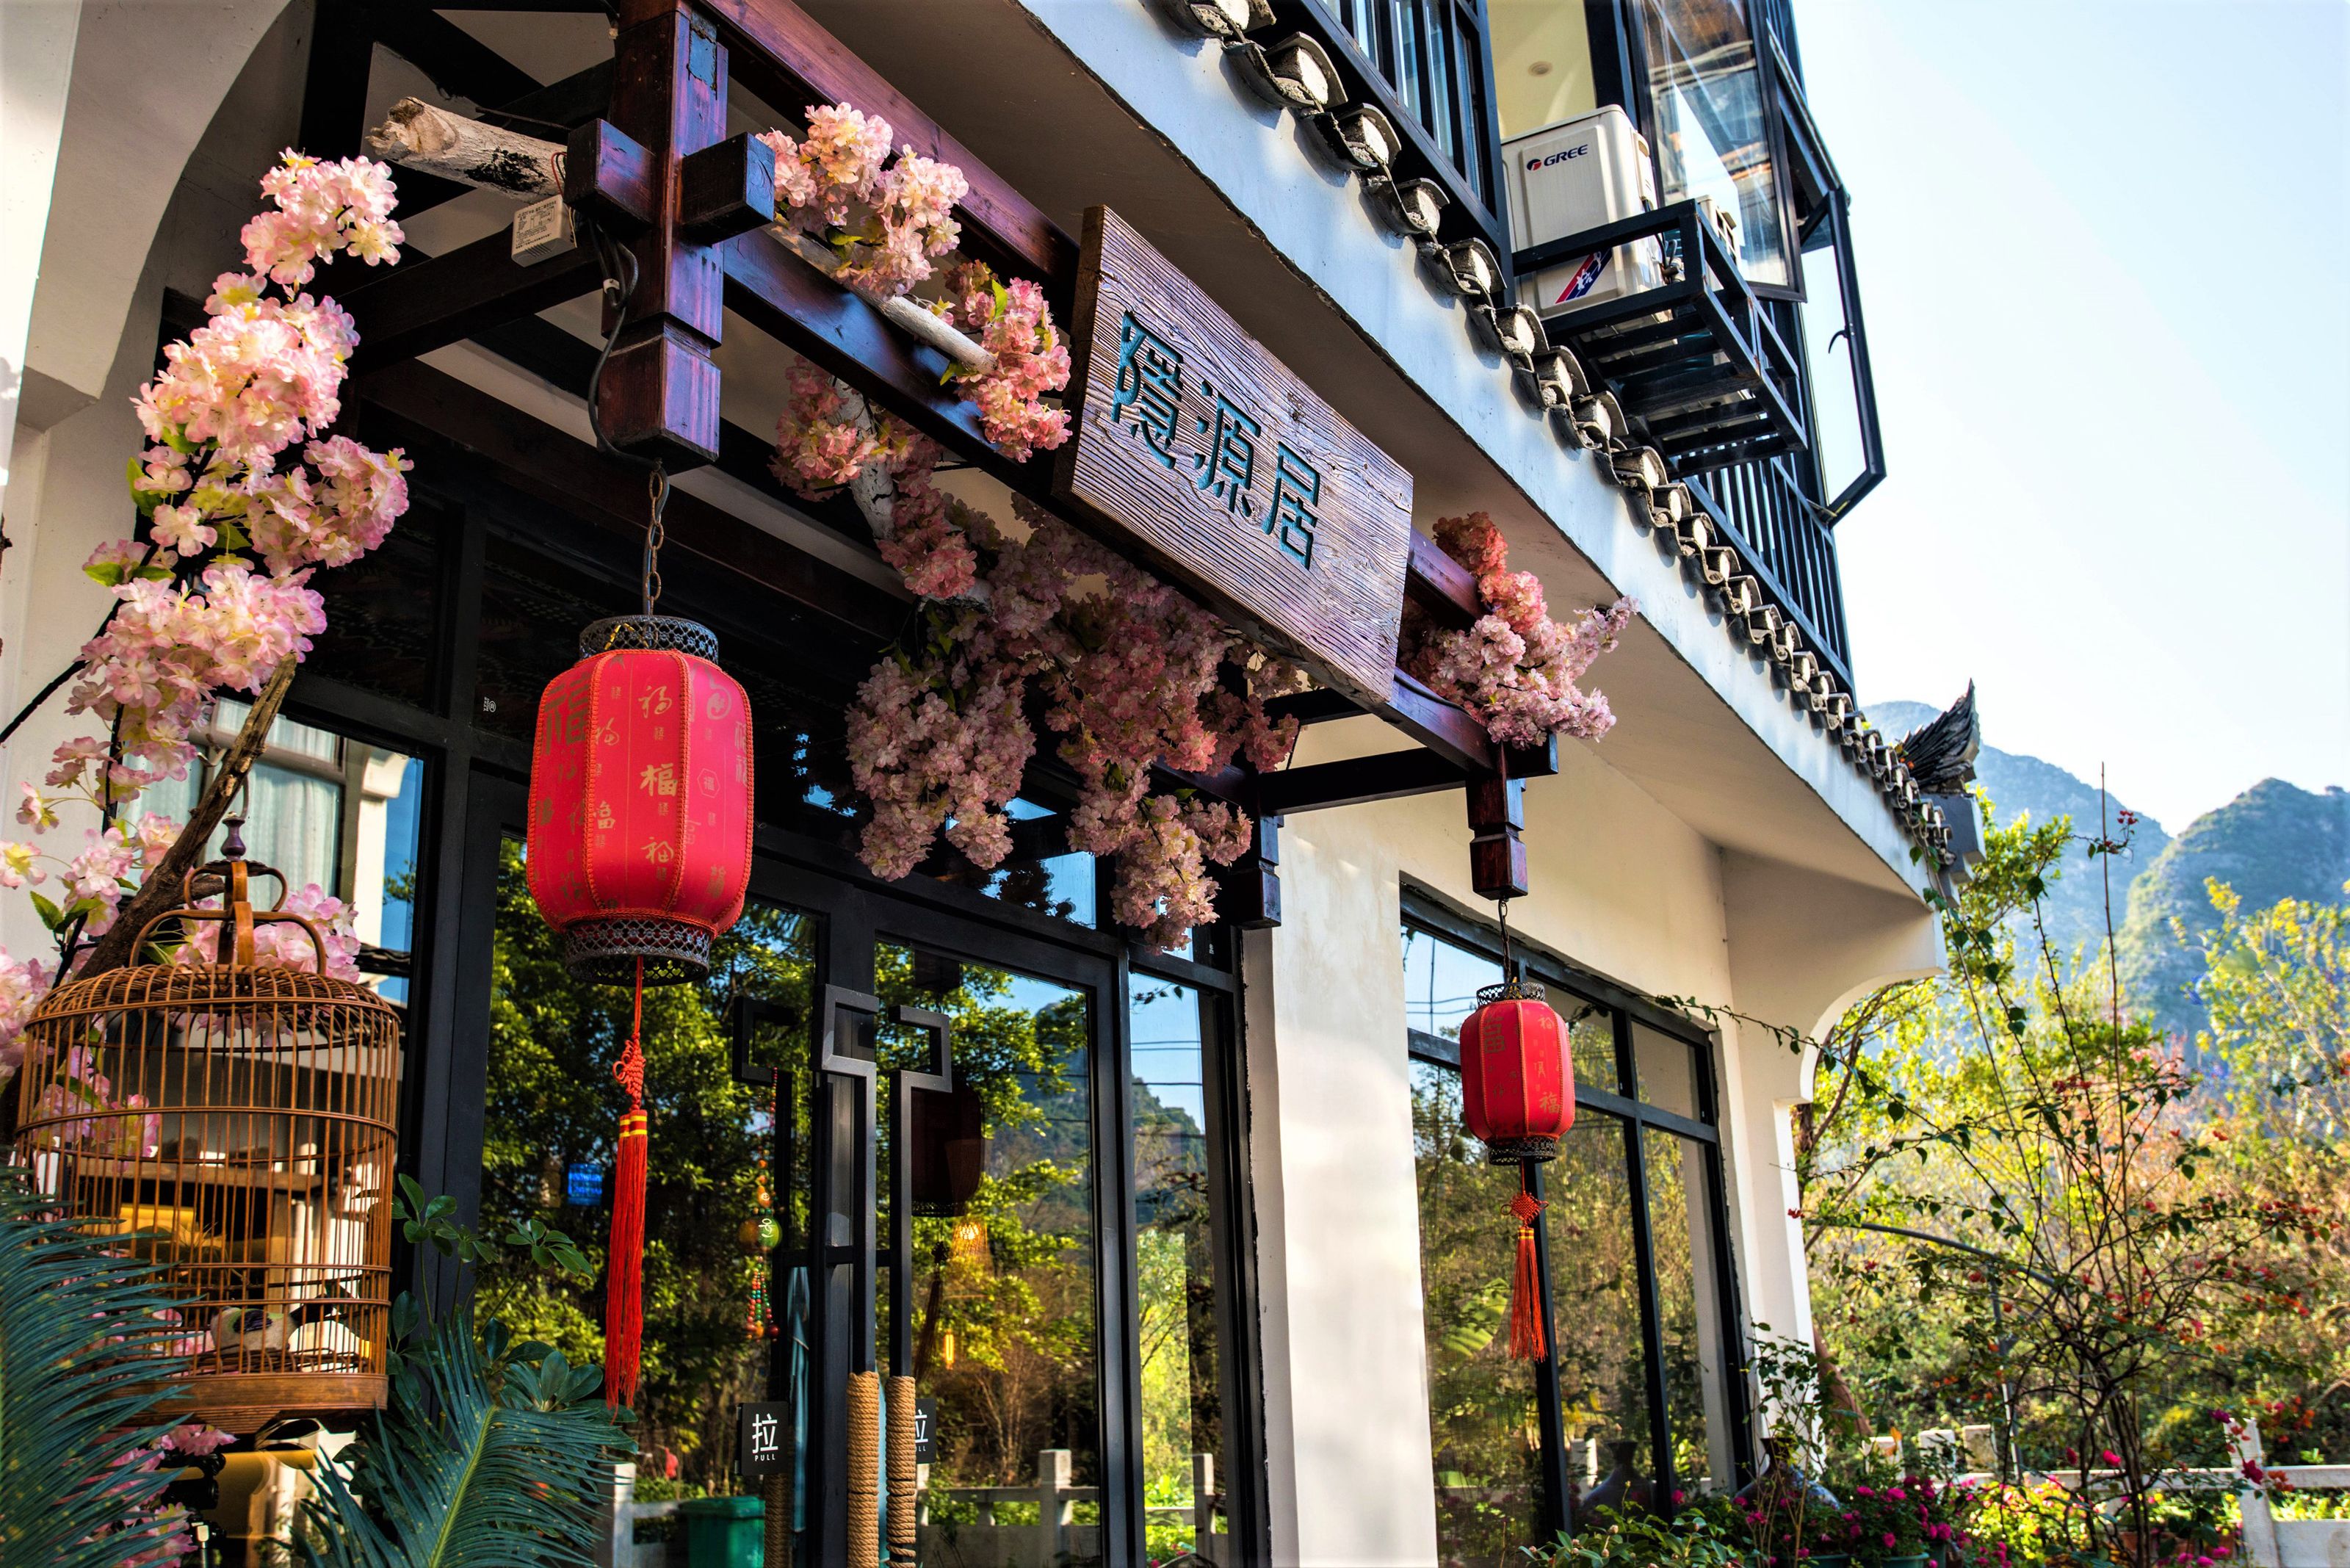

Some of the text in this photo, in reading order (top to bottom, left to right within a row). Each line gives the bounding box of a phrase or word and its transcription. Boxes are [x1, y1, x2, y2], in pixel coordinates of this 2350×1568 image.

[1544, 144, 1588, 166] GREE
[640, 762, 679, 798] 福
[752, 1413, 778, 1453] 拉
